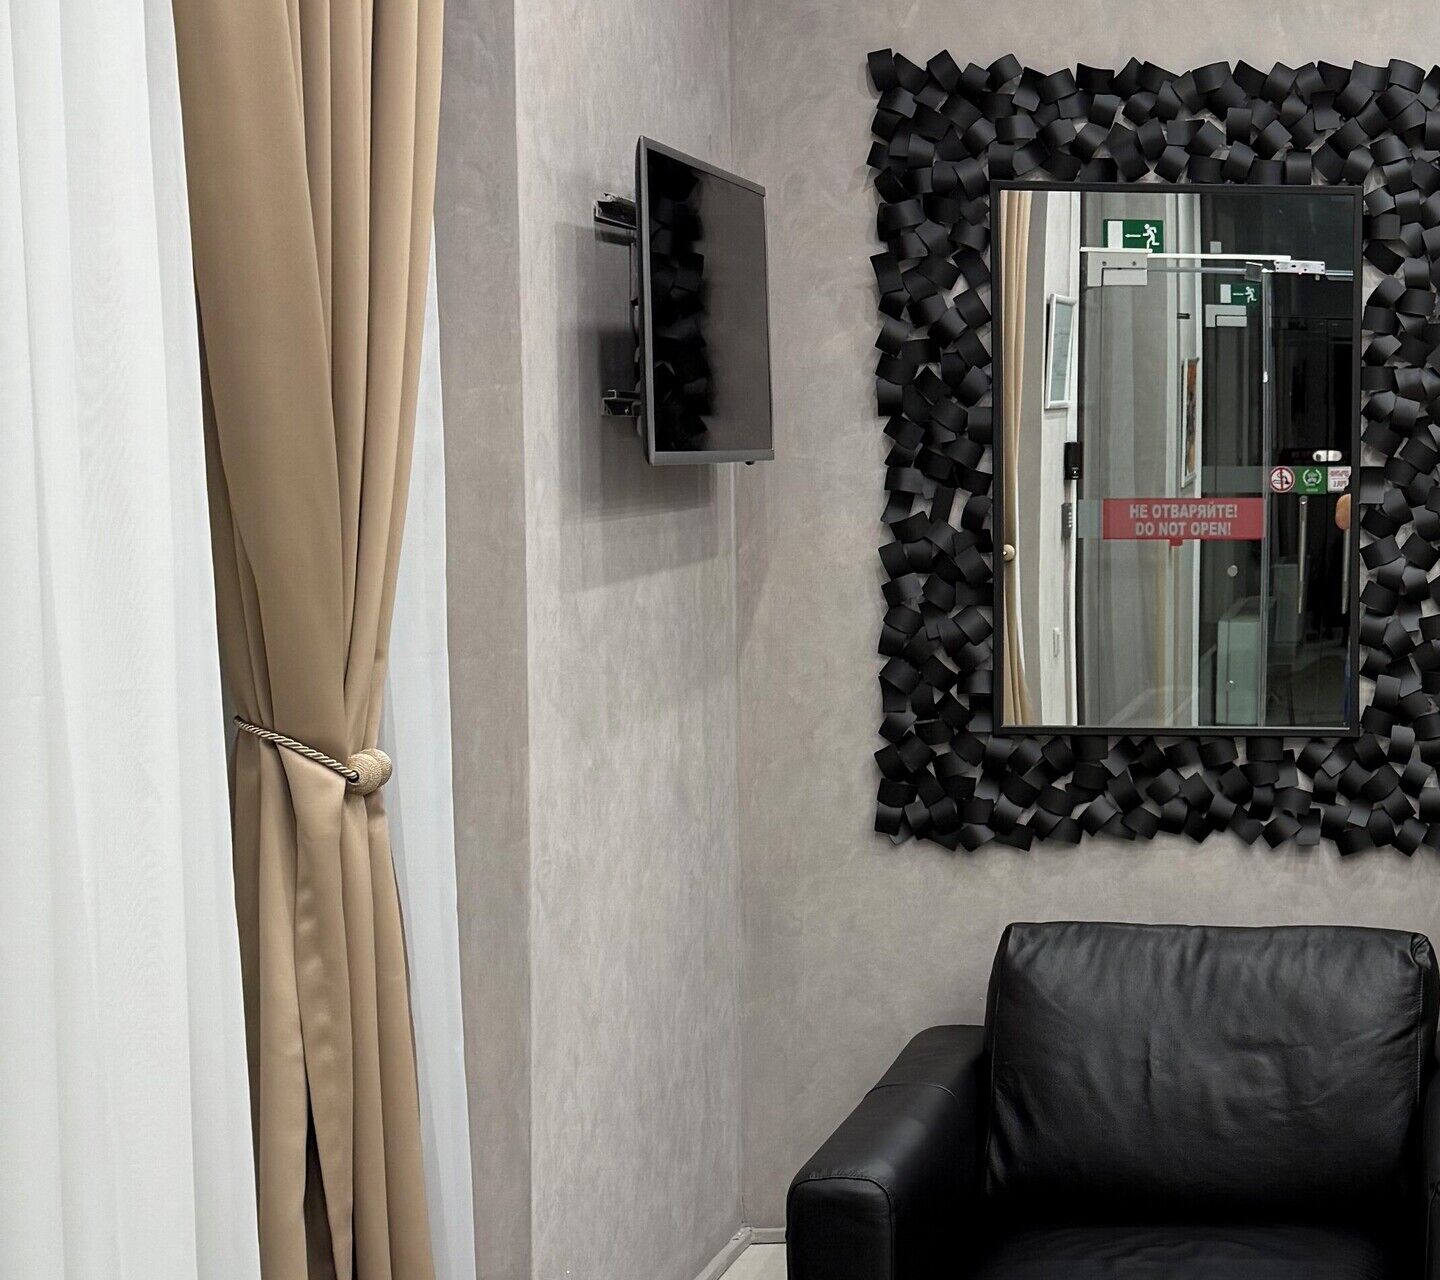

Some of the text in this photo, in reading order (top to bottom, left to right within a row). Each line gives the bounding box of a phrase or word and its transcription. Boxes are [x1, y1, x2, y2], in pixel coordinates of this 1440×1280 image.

[1129, 501, 1238, 518] НЕ ОТВАРЯЙТЕ!
[1135, 522, 1231, 535] DO NOT OPEN!
